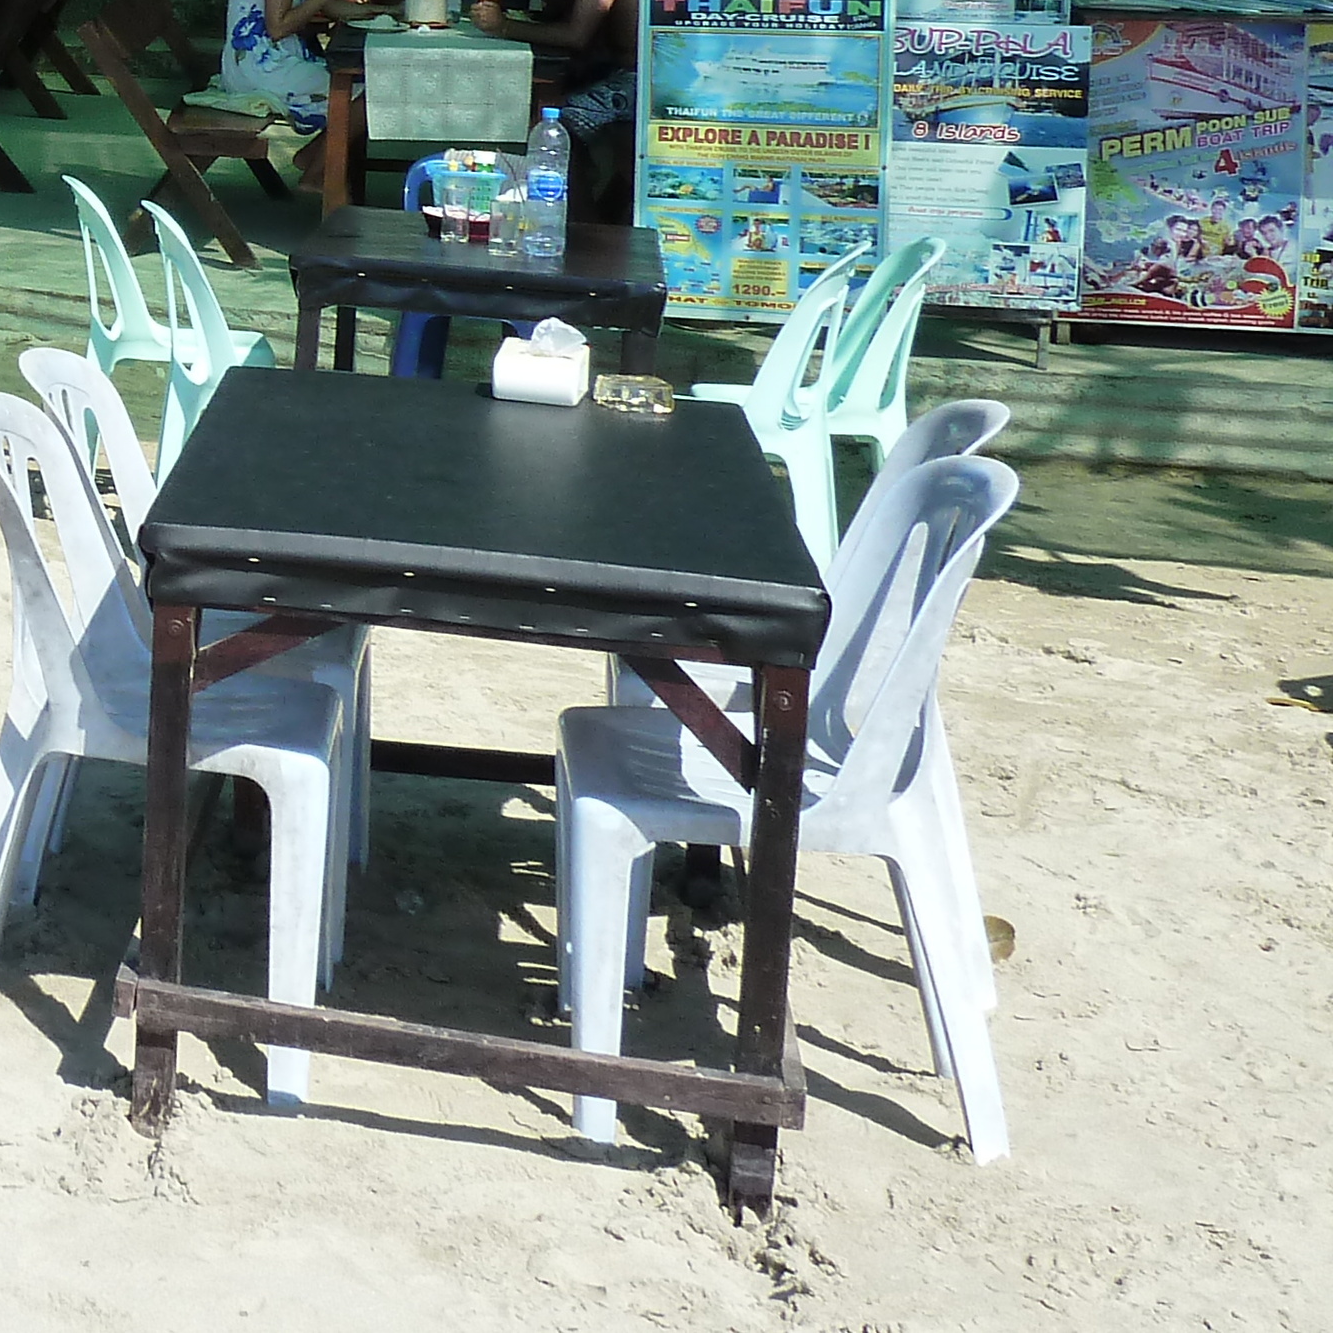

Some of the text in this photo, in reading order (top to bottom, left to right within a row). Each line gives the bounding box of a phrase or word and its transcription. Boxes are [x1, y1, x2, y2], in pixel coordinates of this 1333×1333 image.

[674, 19, 737, 28] UPGRADE
[743, 21, 779, 29] YOUR
[690, 11, 840, 24] DAY-CRUISE
[893, 84, 923, 95] DAILY
[979, 86, 1031, 98] CRUISING
[1034, 87, 1084, 99] SERVICE
[666, 106, 718, 118] THAIFUN
[912, 120, 928, 138] 8
[1100, 124, 1192, 161] PERM
[1196, 114, 1248, 135] POON
[1253, 107, 1292, 126] SUB
[1196, 121, 1291, 148] BOAT TRIP
[658, 126, 743, 145] EXPLORE
[748, 129, 761, 146] A
[766, 130, 859, 149] PARADISE
[1214, 147, 1240, 176] 4
[733, 299, 796, 310] TOMO
